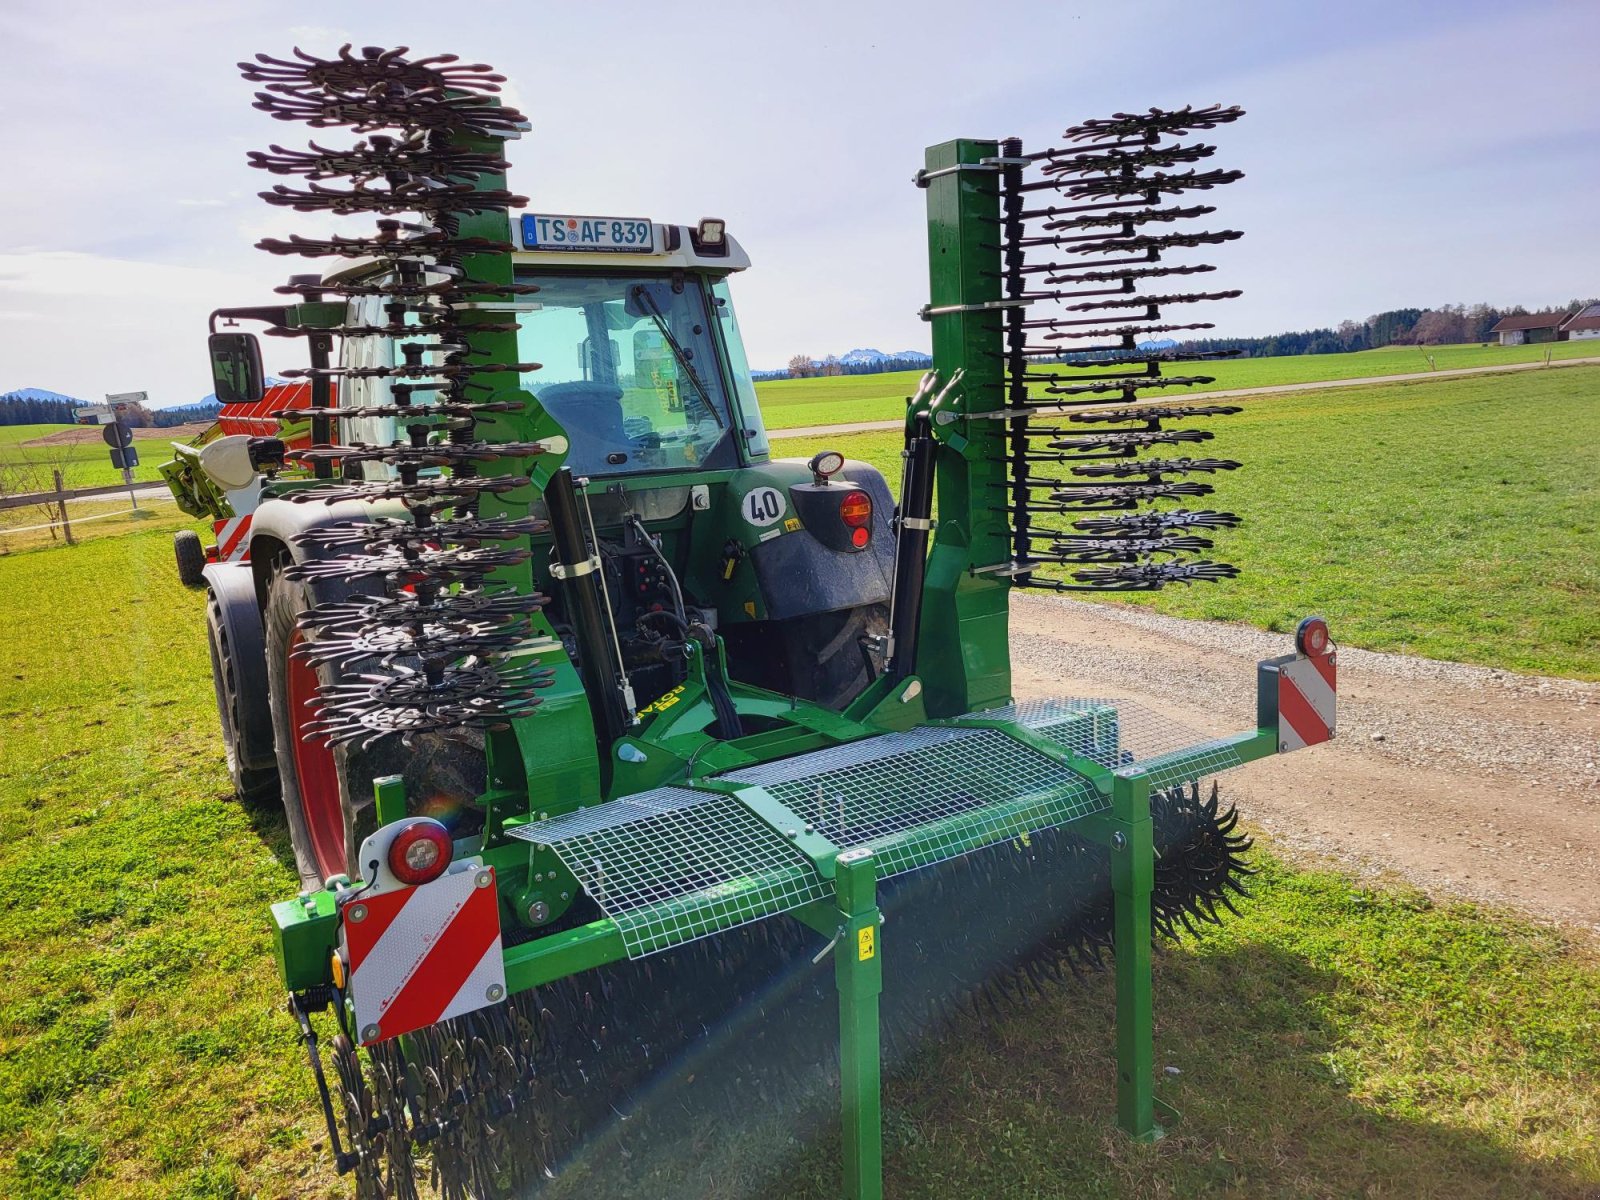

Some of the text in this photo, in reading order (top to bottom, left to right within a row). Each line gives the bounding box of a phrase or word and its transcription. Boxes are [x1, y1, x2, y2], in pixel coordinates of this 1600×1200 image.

[537, 218, 648, 244] TS AF 839
[751, 490, 780, 521] 40
[636, 685, 686, 719] ROTAR
